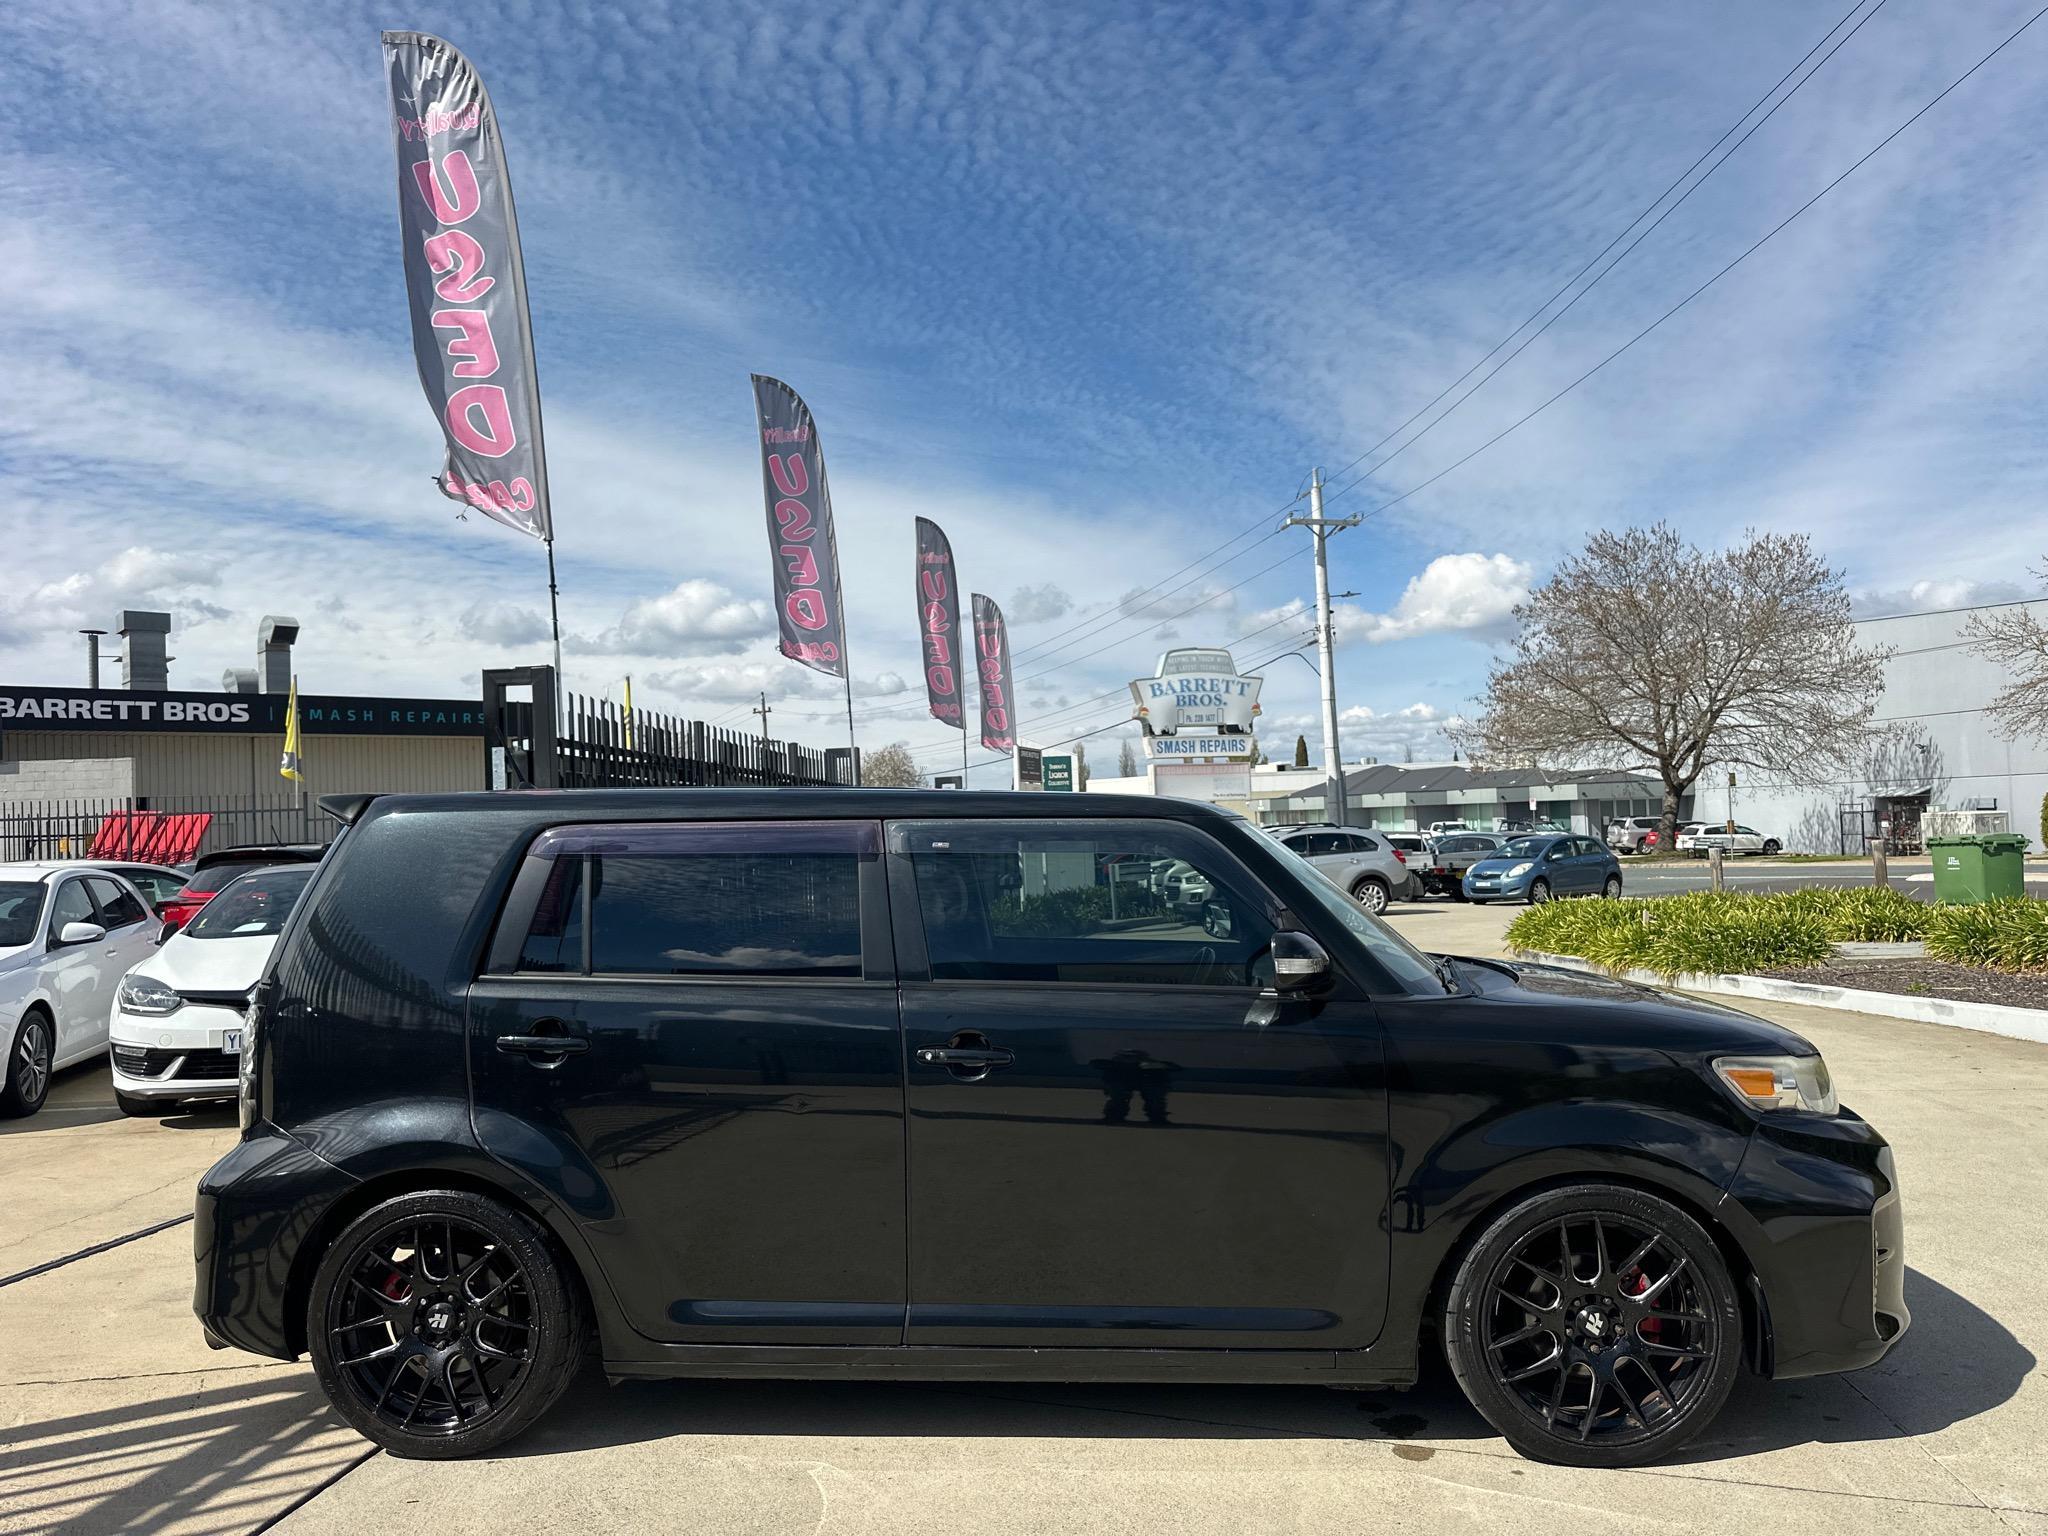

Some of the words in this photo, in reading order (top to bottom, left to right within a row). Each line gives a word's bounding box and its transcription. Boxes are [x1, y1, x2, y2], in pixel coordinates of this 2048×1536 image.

[1149, 678, 1251, 698] BARRETT
[1176, 694, 1228, 707] BROS.
[163, 701, 250, 722] BROS
[1156, 740, 1195, 754] SMASH
[1200, 738, 1246, 753] REPAIRS
